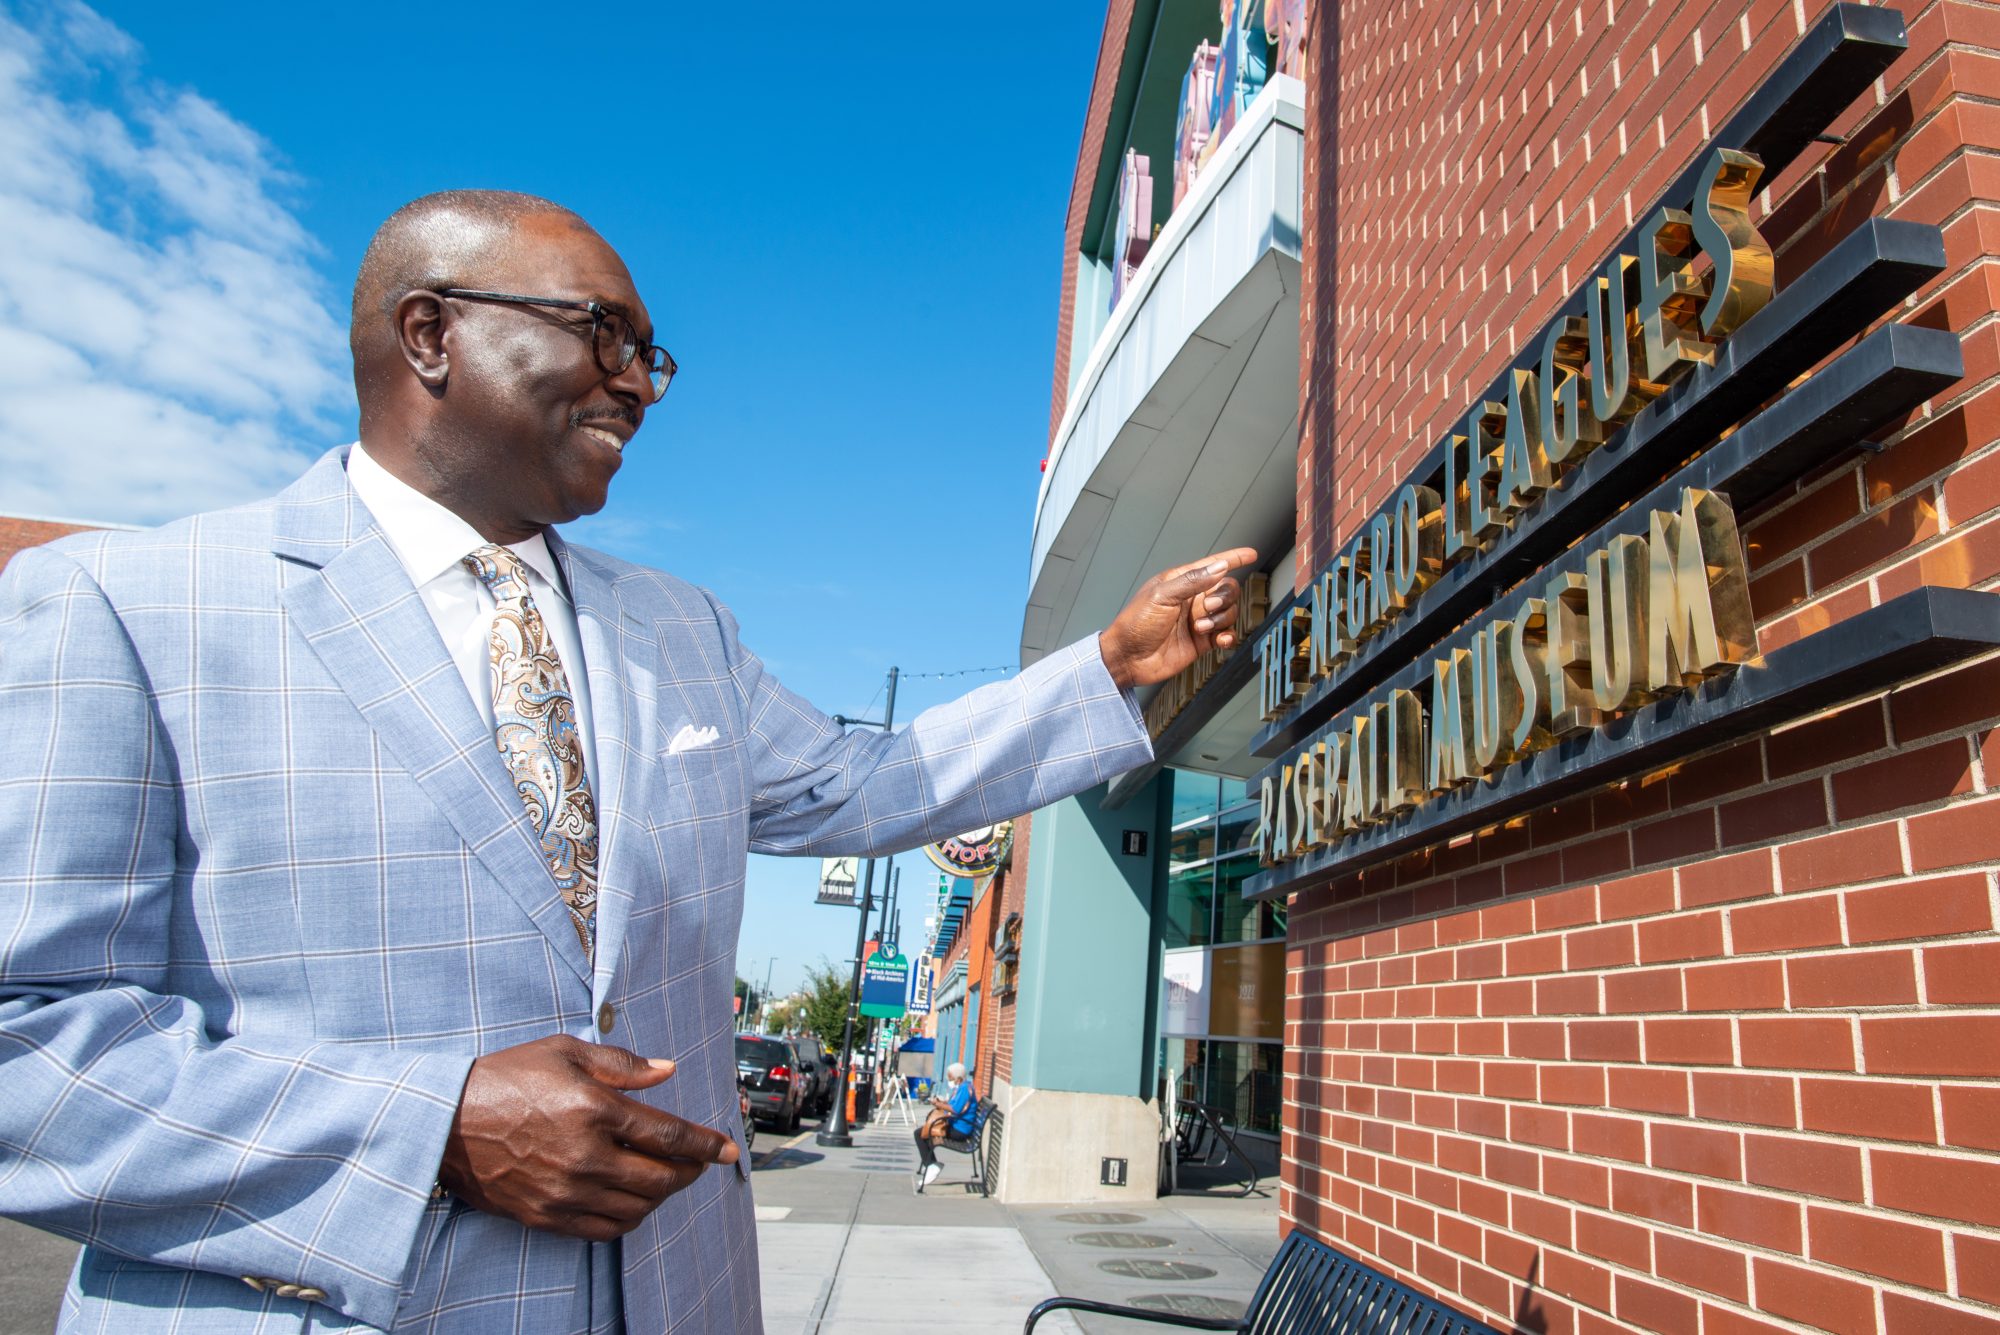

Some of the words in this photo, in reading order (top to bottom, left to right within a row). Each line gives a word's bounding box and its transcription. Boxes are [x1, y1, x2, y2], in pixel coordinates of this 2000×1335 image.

[1259, 606, 1312, 722] THE
[1310, 484, 1428, 678] NEGRO
[1445, 147, 1760, 560] LEAGUES
[1259, 689, 1416, 867] BASEBALL
[1430, 486, 1755, 791] MUSEUM
[941, 839, 990, 863] HOP
[918, 956, 929, 1000] BLUE
